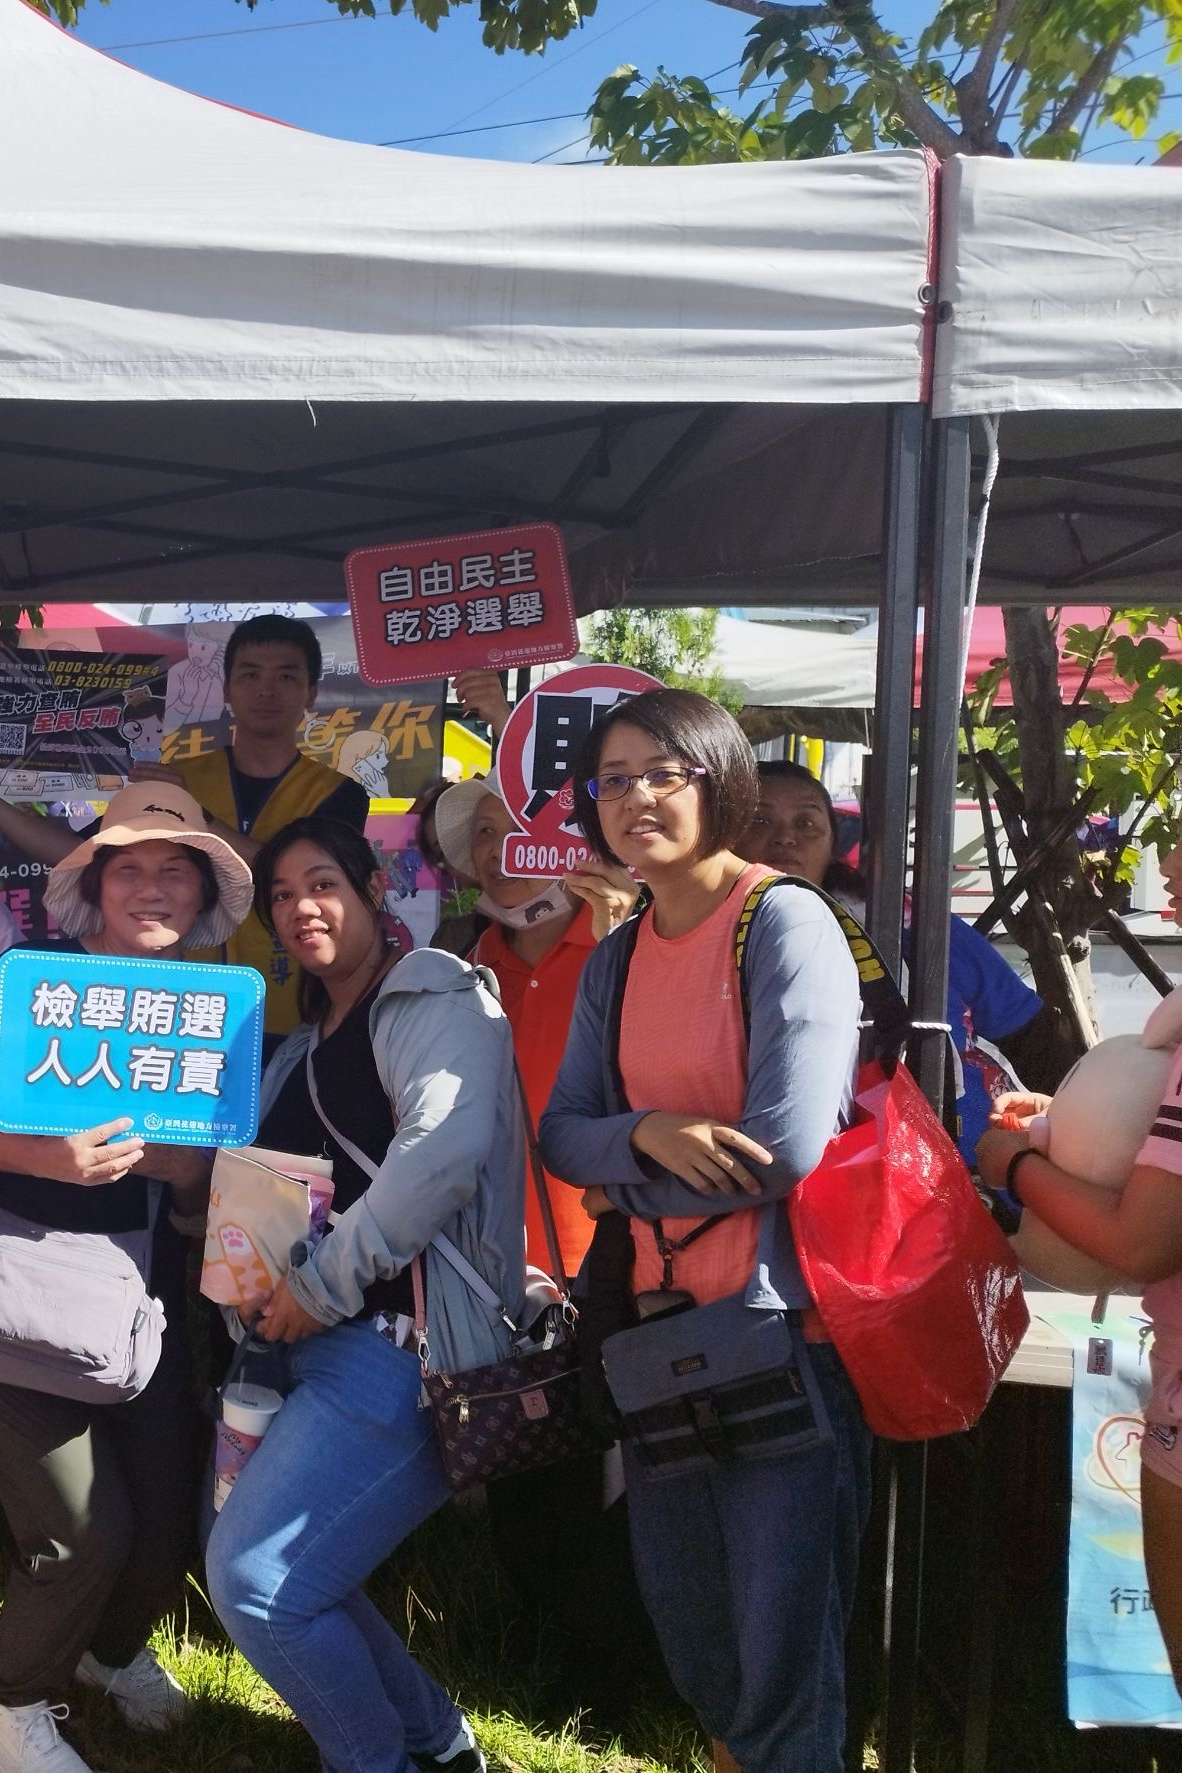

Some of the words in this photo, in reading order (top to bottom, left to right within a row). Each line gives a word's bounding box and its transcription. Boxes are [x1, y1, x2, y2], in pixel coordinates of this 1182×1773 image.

[380, 549, 536, 602] 自由民主
[386, 591, 543, 645] 乾淨選舉
[32, 707, 121, 734] 全民反賄
[515, 845, 597, 871] 0800-02
[30, 980, 227, 1040] 檢舉賄選
[26, 1038, 225, 1097] 人人有責
